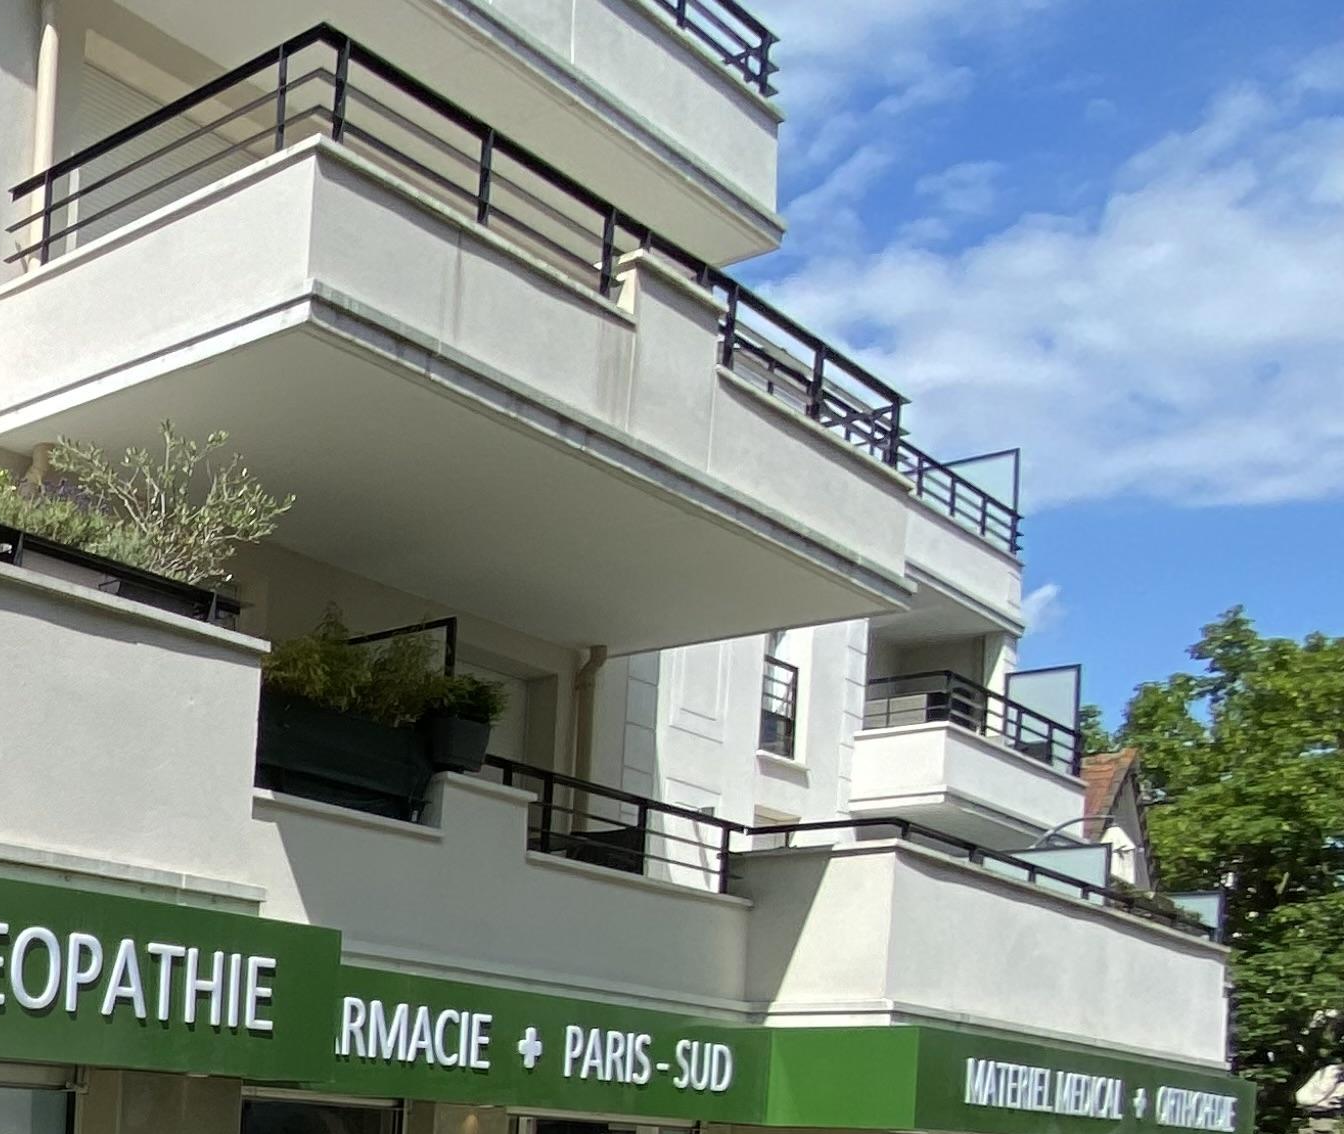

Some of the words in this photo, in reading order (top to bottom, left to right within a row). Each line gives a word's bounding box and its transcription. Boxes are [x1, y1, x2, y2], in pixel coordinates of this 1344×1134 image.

[335, 996, 493, 1069] RMACIE
[965, 1057, 1053, 1112] MATERIEL
[1054, 1070, 1123, 1120] MEDICAL
